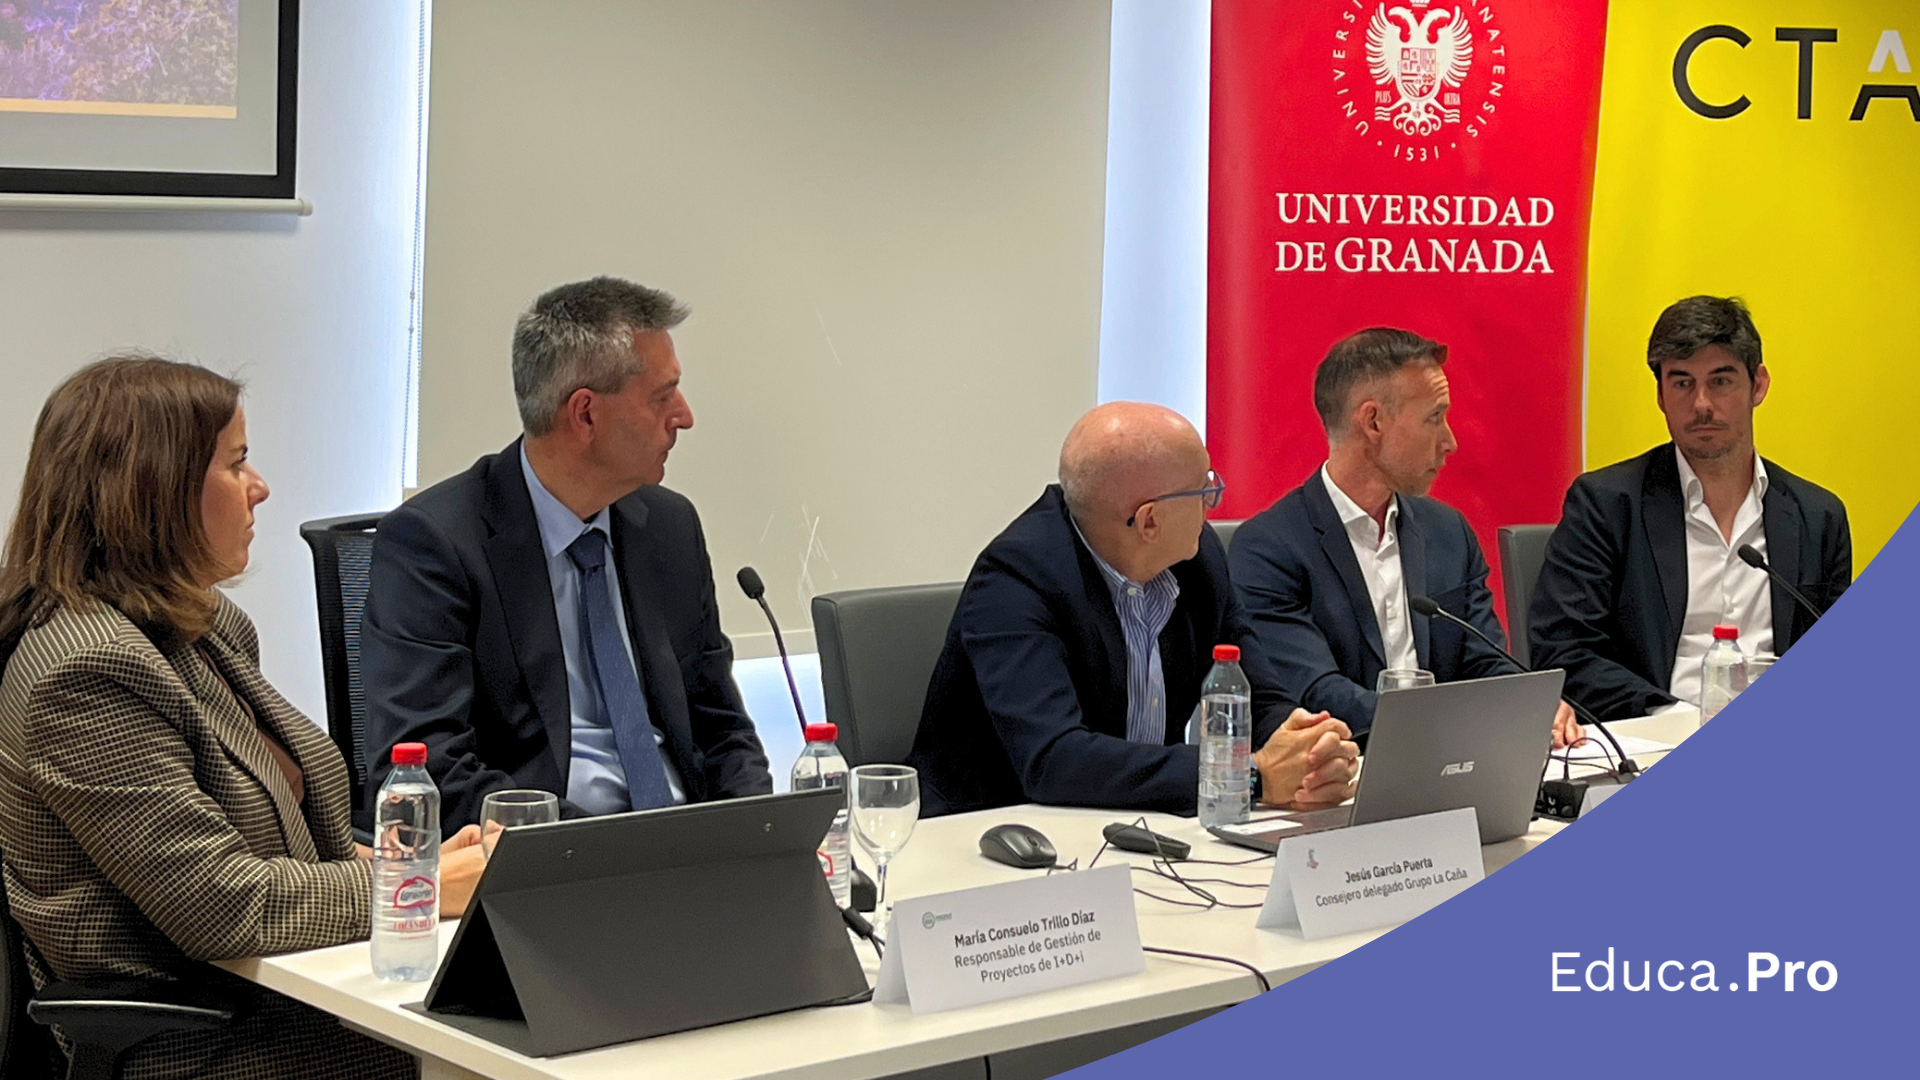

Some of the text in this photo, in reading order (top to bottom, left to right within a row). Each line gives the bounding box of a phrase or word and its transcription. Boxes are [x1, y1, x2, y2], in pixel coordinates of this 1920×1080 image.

[1672, 24, 1920, 122] CTA
[1393, 144, 1440, 162] 1531
[1275, 192, 1555, 227] UNIVERSIDAD
[1274, 236, 1555, 274] DE GRANADA
[1440, 761, 1475, 777] ASUS
[1315, 867, 1468, 907] Consejero delegado Grupo La Caña
[1345, 857, 1433, 884] Jesús García Puerta
[954, 909, 1096, 948] María Consuelo Trillo Díaz
[954, 928, 1102, 969] Responsable de Gestión de
[980, 962, 1037, 983] Proyectos
[1038, 958, 1052, 972] de
